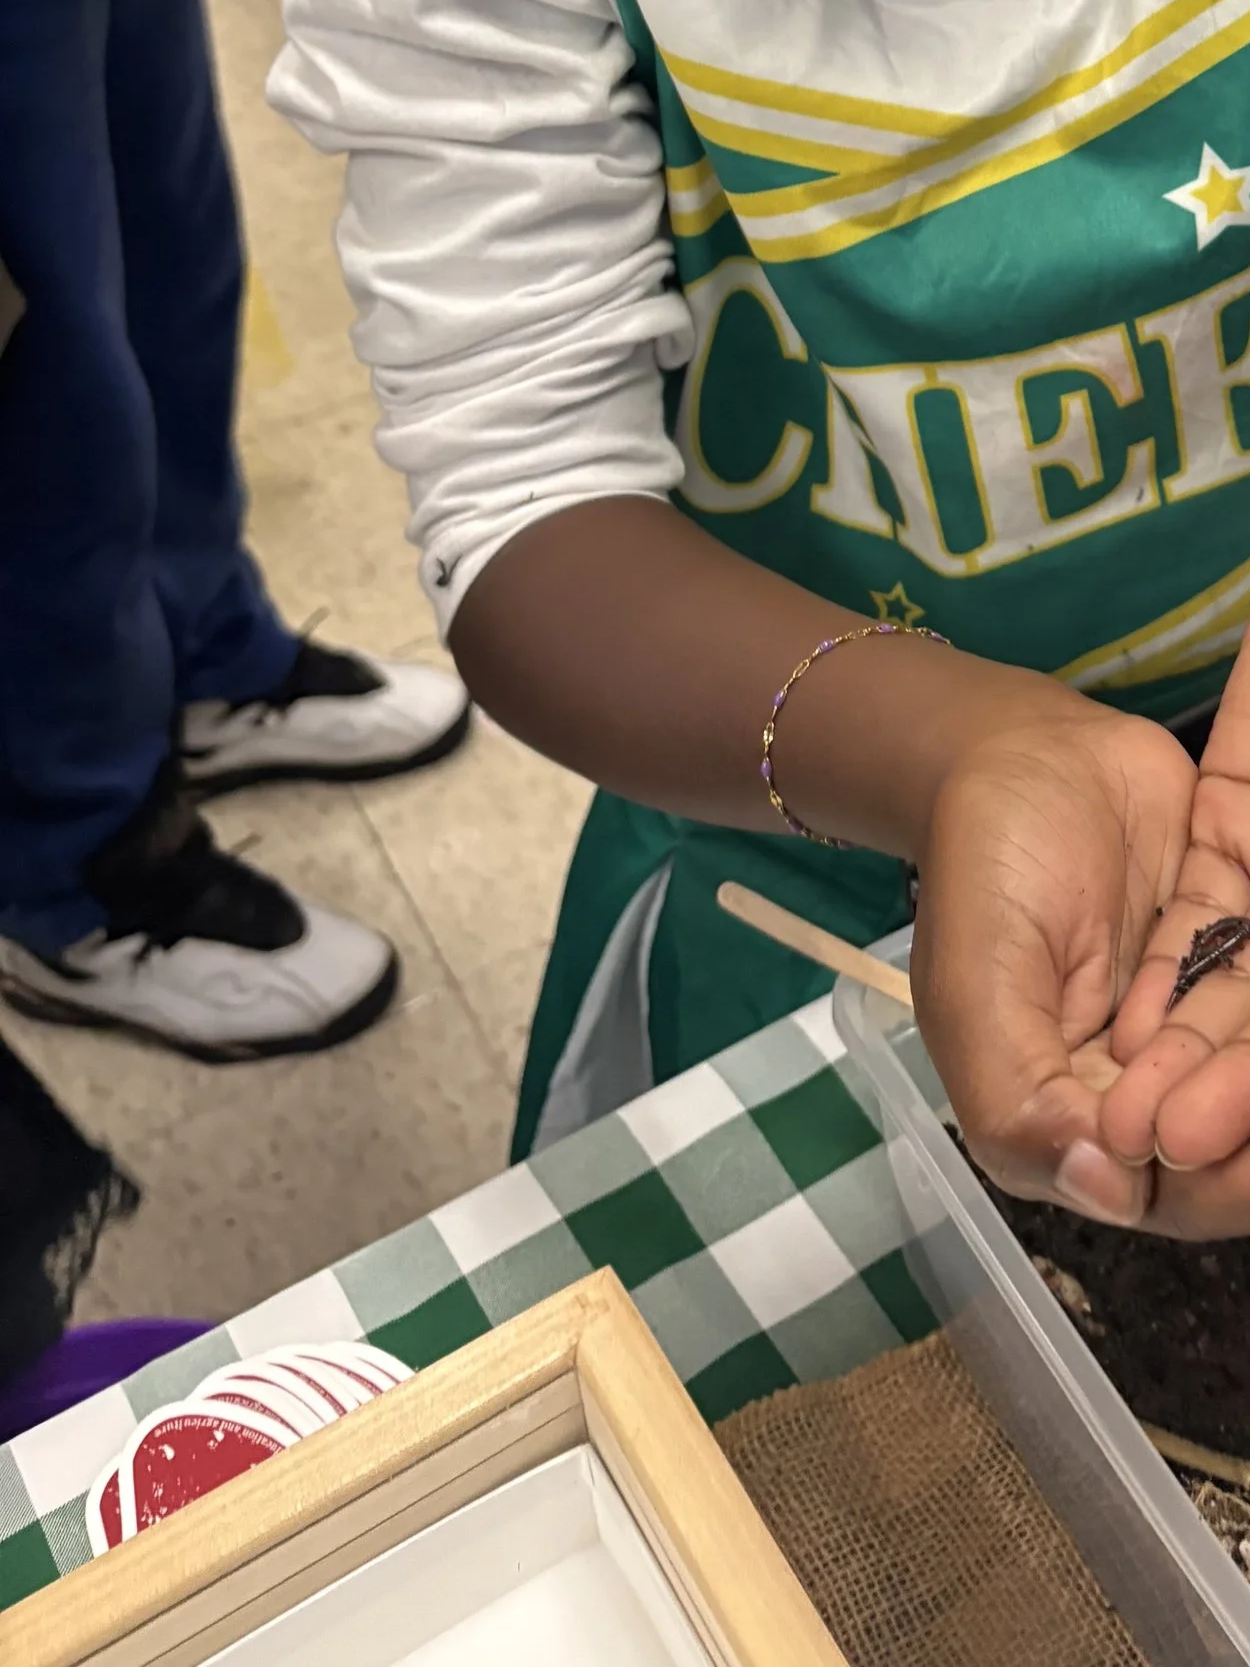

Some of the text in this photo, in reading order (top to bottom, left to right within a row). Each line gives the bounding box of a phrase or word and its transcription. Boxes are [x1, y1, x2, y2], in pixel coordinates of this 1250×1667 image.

[154, 1415, 284, 1454] ucation and agriculture
